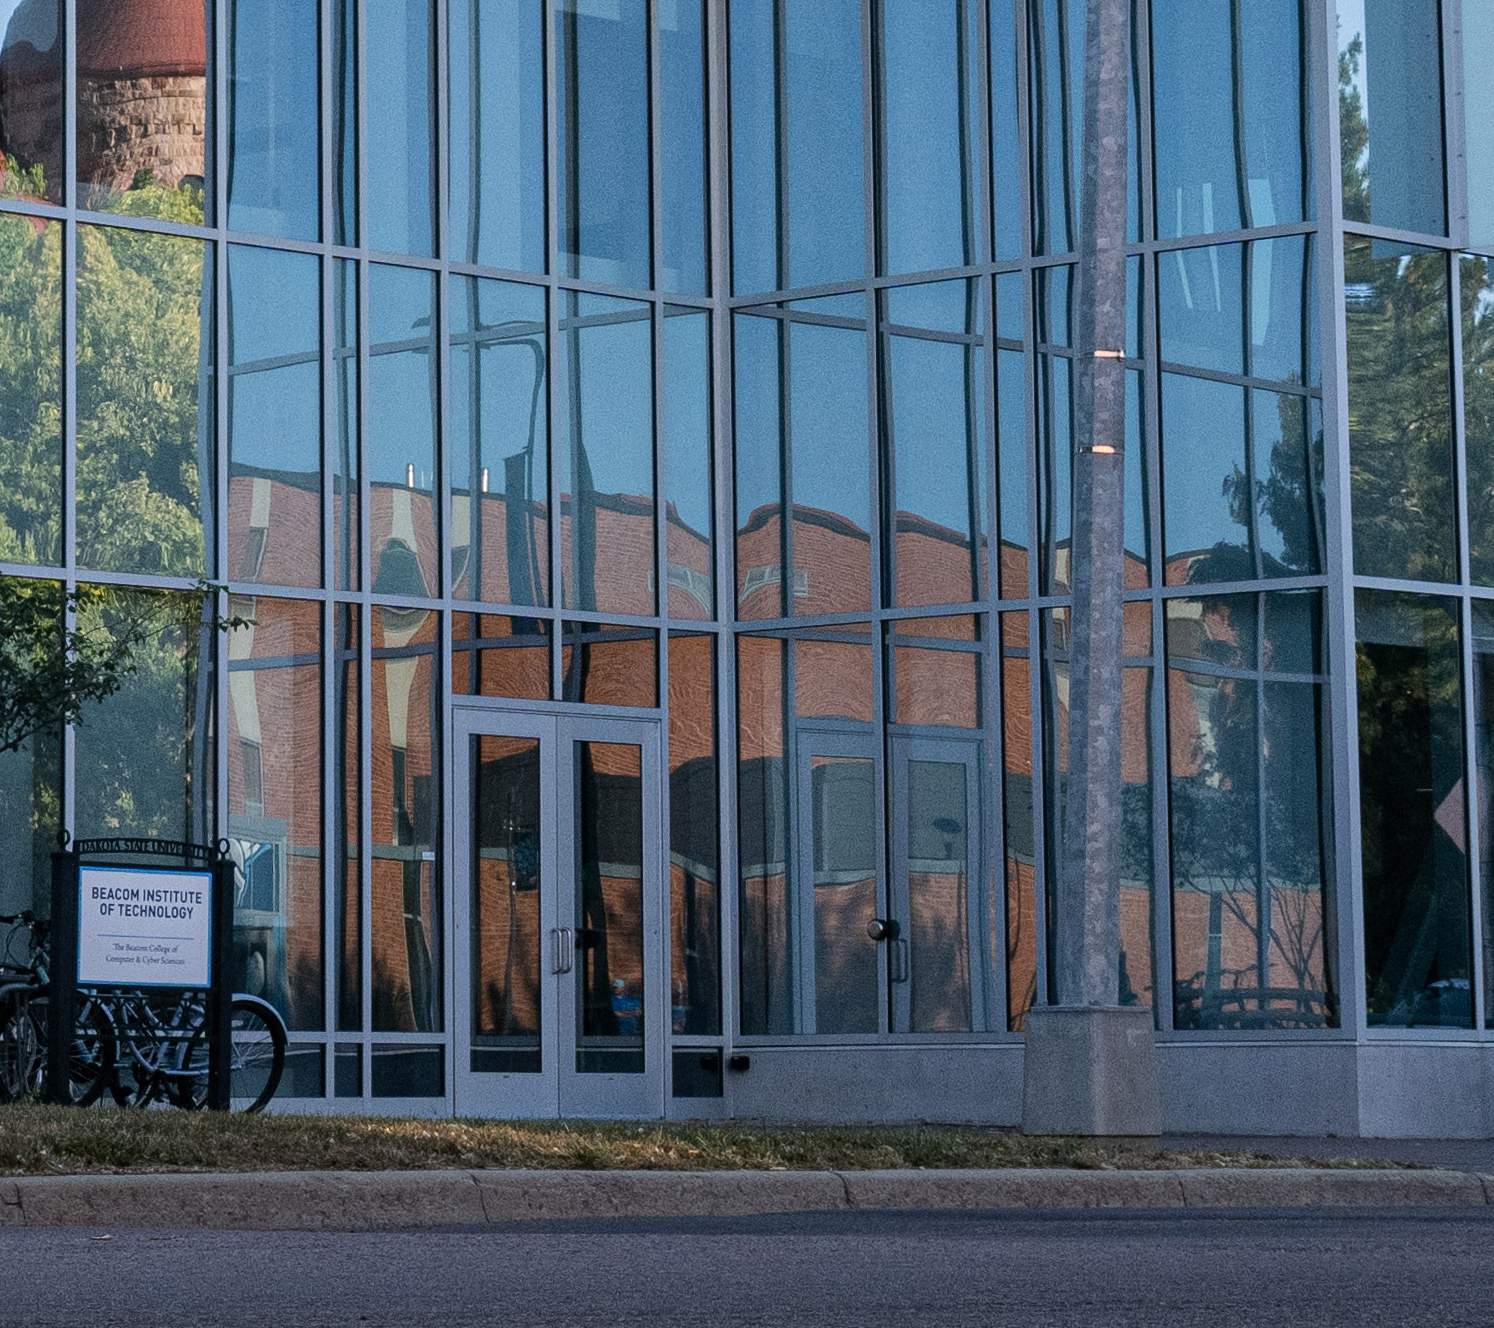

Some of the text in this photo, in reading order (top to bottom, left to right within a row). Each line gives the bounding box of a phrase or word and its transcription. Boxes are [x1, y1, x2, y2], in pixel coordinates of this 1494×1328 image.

[81, 839, 121, 852] DAKOTA
[124, 839, 150, 852] STATE
[92, 887, 202, 904] BEACOM INSTITUTE
[100, 902, 193, 919] OF TECHNOLOGY
[113, 943, 179, 955] The Beacom College of
[105, 954, 134, 965] Computer
[142, 956, 160, 966] Cyber
[161, 957, 185, 965] Sciences
